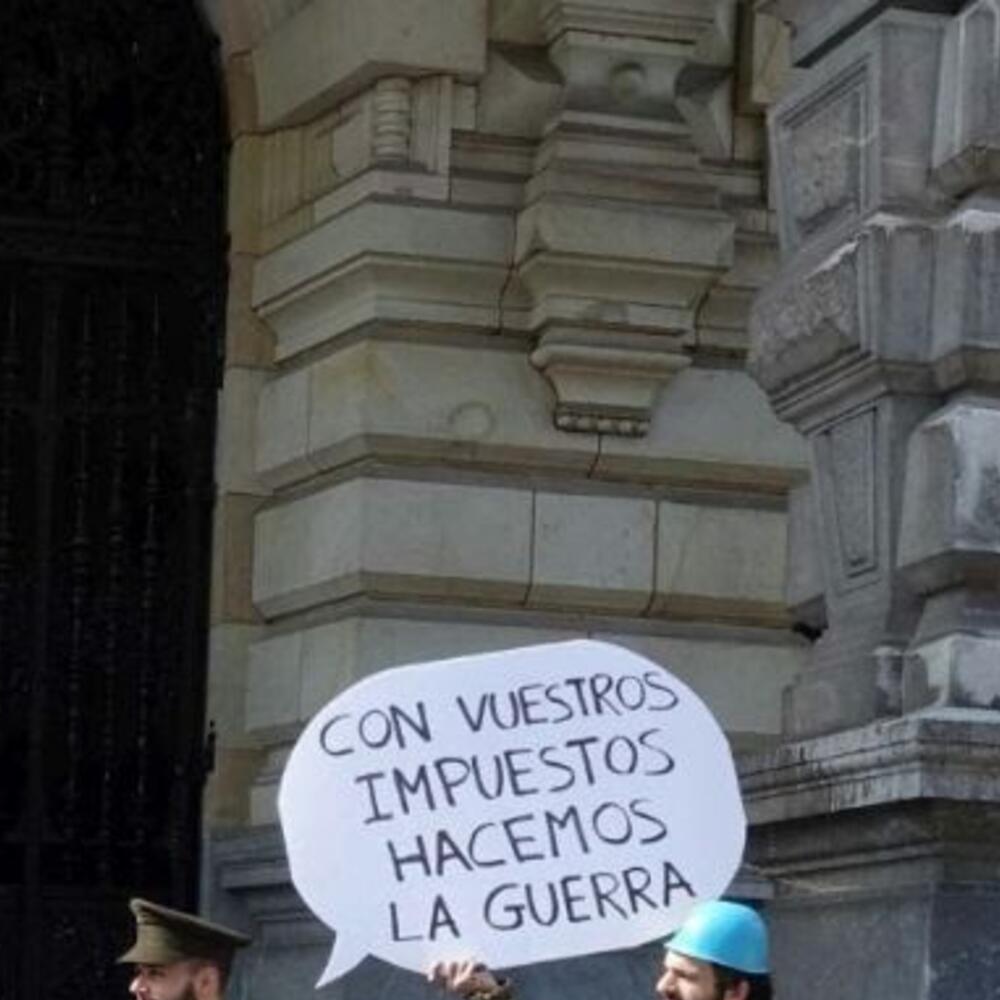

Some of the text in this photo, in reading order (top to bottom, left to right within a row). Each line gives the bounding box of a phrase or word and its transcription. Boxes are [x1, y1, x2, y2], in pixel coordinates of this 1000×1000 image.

[319, 672, 680, 757] CON VUESTROS
[355, 729, 675, 825] IMPUESTOS
[388, 799, 668, 882] HACEMOS
[389, 861, 695, 942] LA GUERRA
